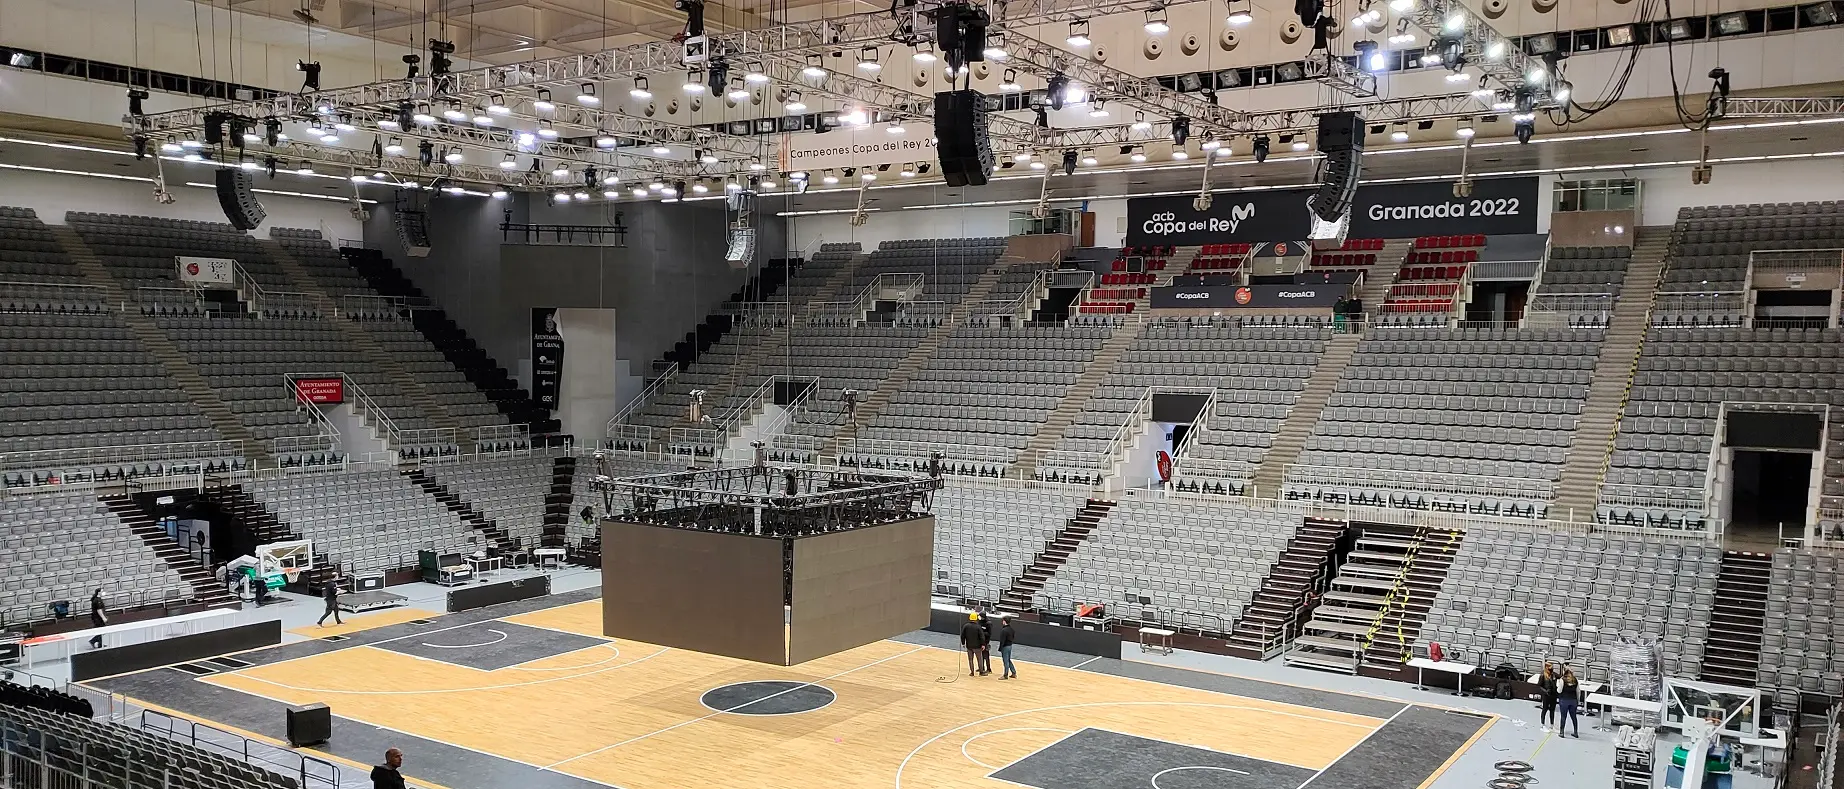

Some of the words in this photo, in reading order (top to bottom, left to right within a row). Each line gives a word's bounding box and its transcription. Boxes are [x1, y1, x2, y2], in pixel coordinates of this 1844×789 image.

[791, 146, 850, 158] Campeones
[852, 144, 880, 154] Copa
[883, 141, 900, 151] del
[903, 139, 922, 150] Rey
[1152, 211, 1175, 222] acb
[1368, 201, 1465, 221] Granada
[1469, 197, 1519, 217] 2022
[1143, 220, 1186, 236] Copa
[1188, 220, 1207, 231] del
[1209, 218, 1240, 234] Rey
[1175, 292, 1209, 300] #CopaACB
